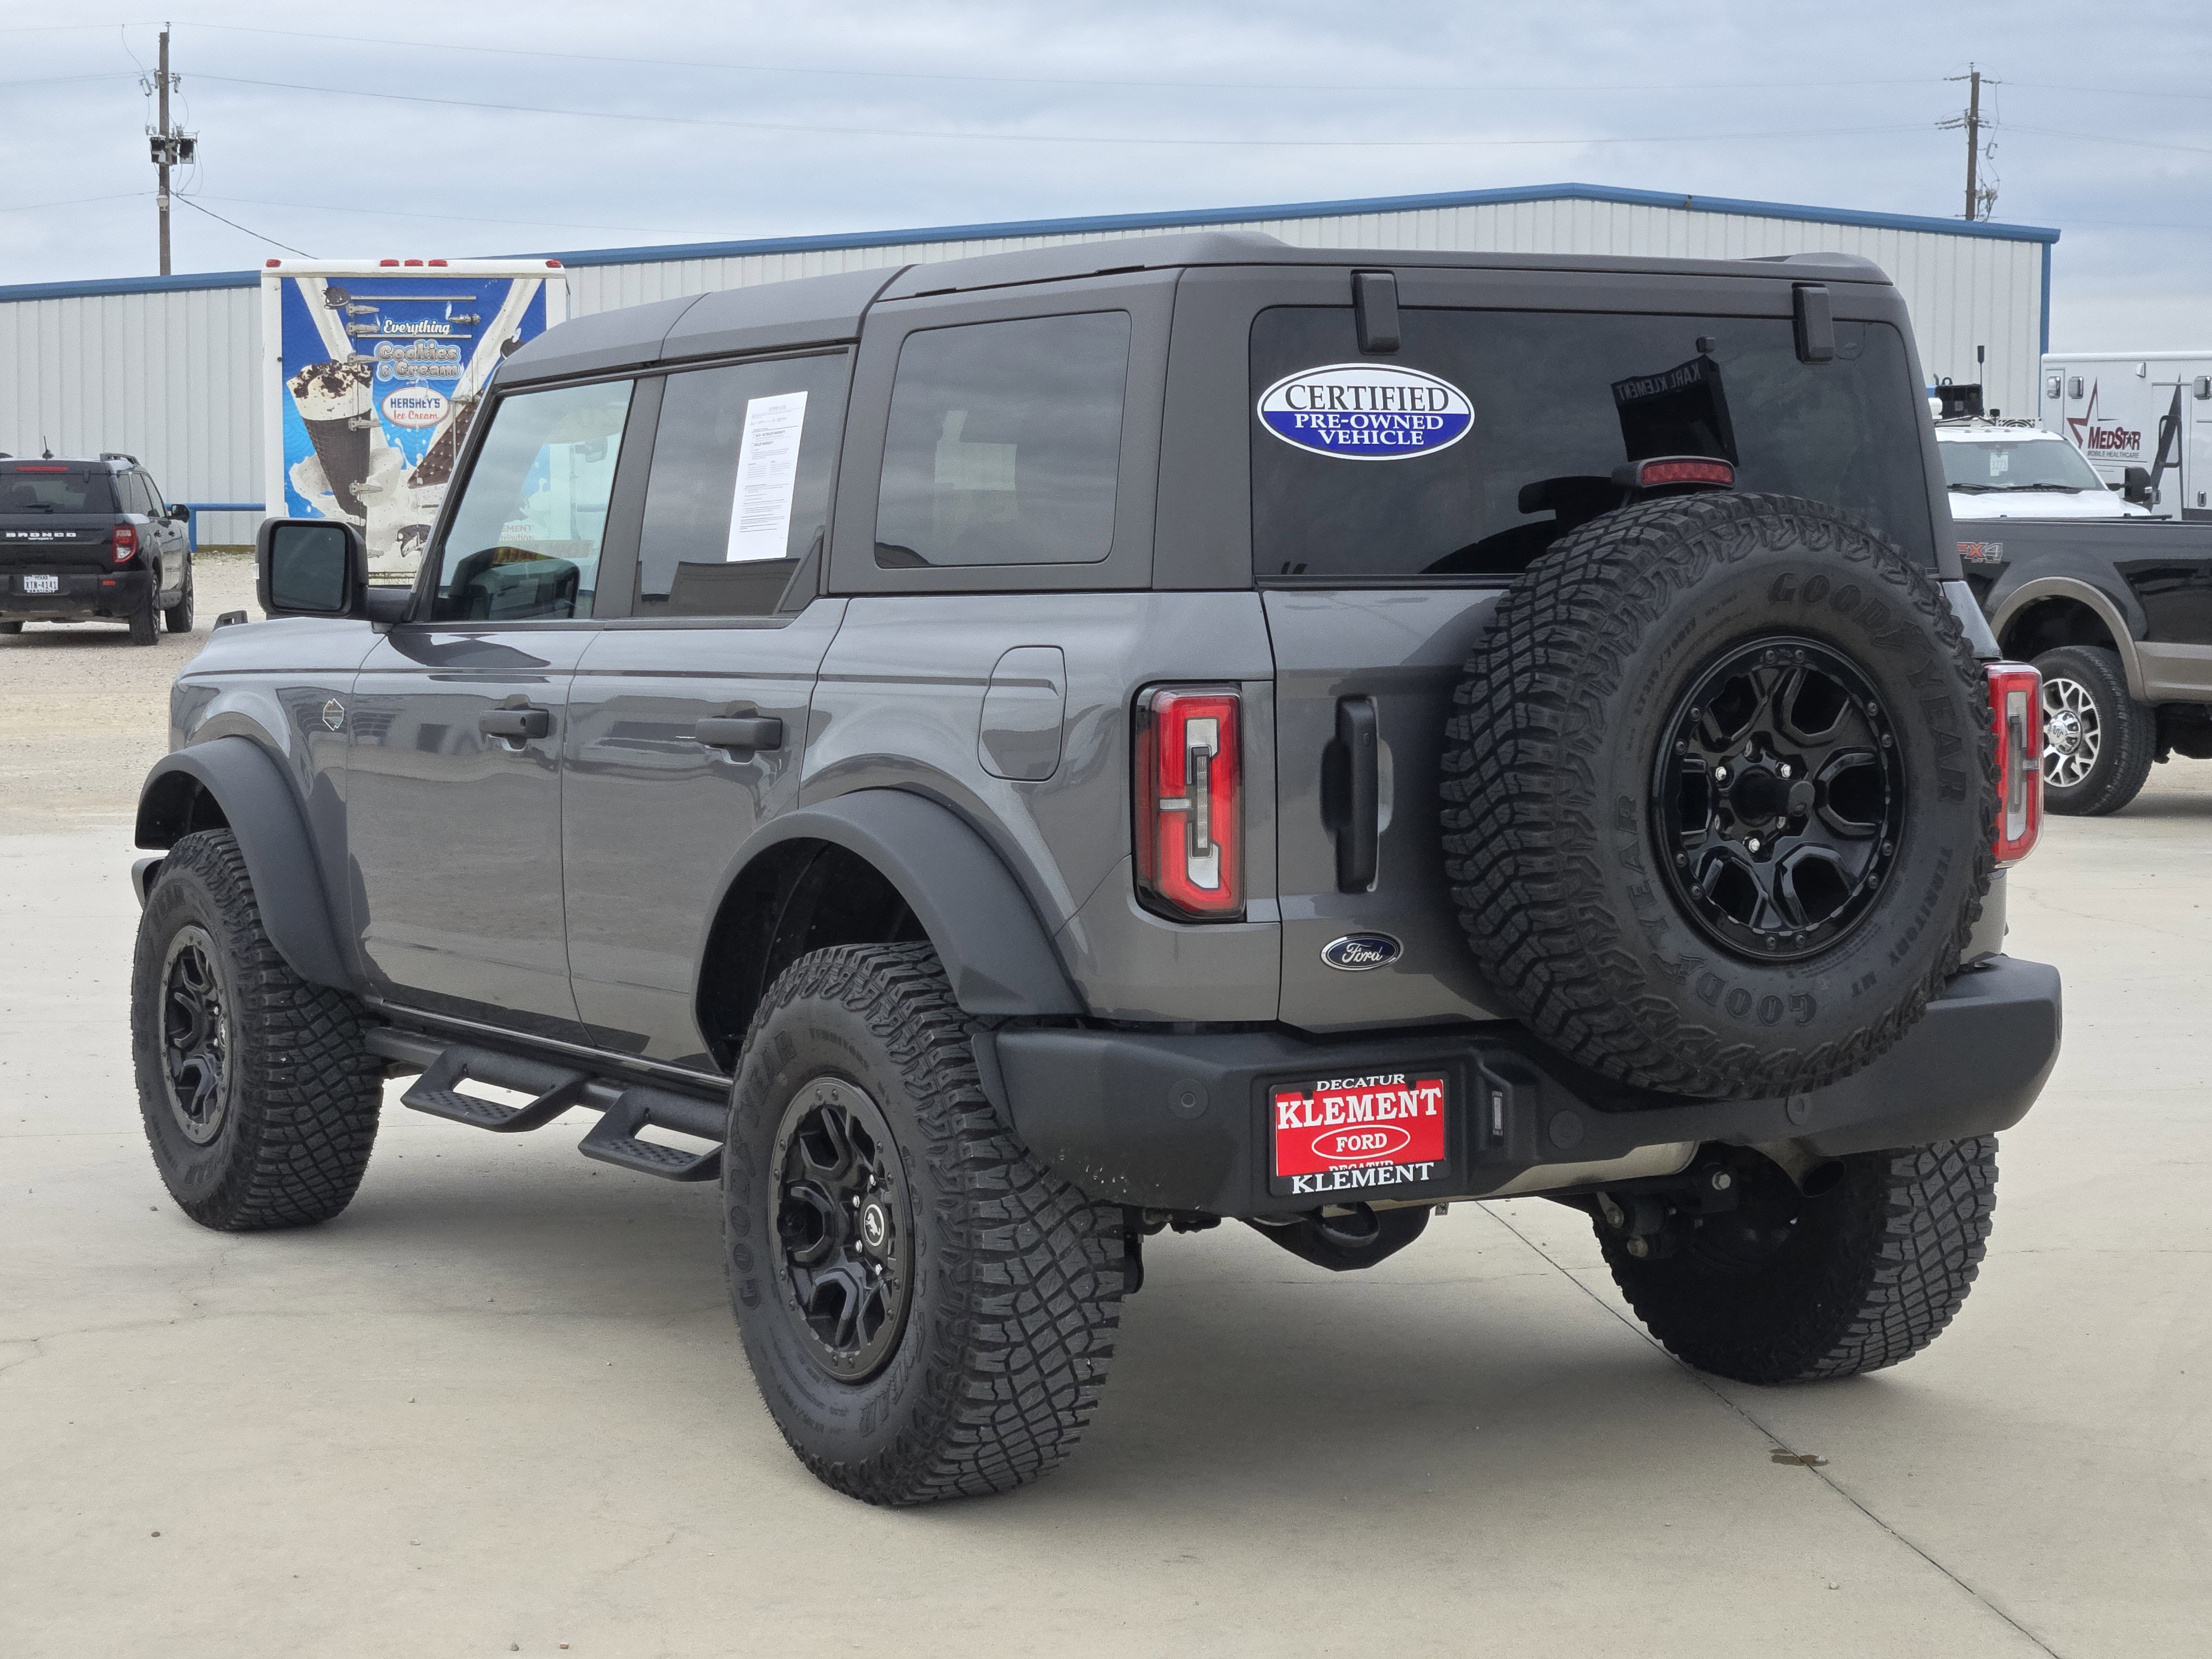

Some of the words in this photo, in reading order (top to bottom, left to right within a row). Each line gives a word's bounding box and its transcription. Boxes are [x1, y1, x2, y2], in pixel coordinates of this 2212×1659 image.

[383, 320, 451, 335] Everything
[377, 342, 458, 361] Cookies
[380, 364, 392, 378] &
[394, 360, 458, 377] Cream
[390, 398, 441, 409] HERSHEY'S
[1285, 384, 1450, 412] CERTIFIED
[394, 409, 406, 419] Ice
[409, 410, 439, 420] Cream
[1294, 414, 1444, 430] PRE-OWNED
[1318, 429, 1425, 446] VEHICLE
[502, 524, 534, 533] EMENT
[1342, 942, 1384, 964] Ford
[1317, 1074, 1405, 1092] DECATUR
[1277, 1087, 1442, 1129] KLEMENT
[1336, 1133, 1387, 1152] FORD
[1292, 1162, 1434, 1194] KLEMENT
